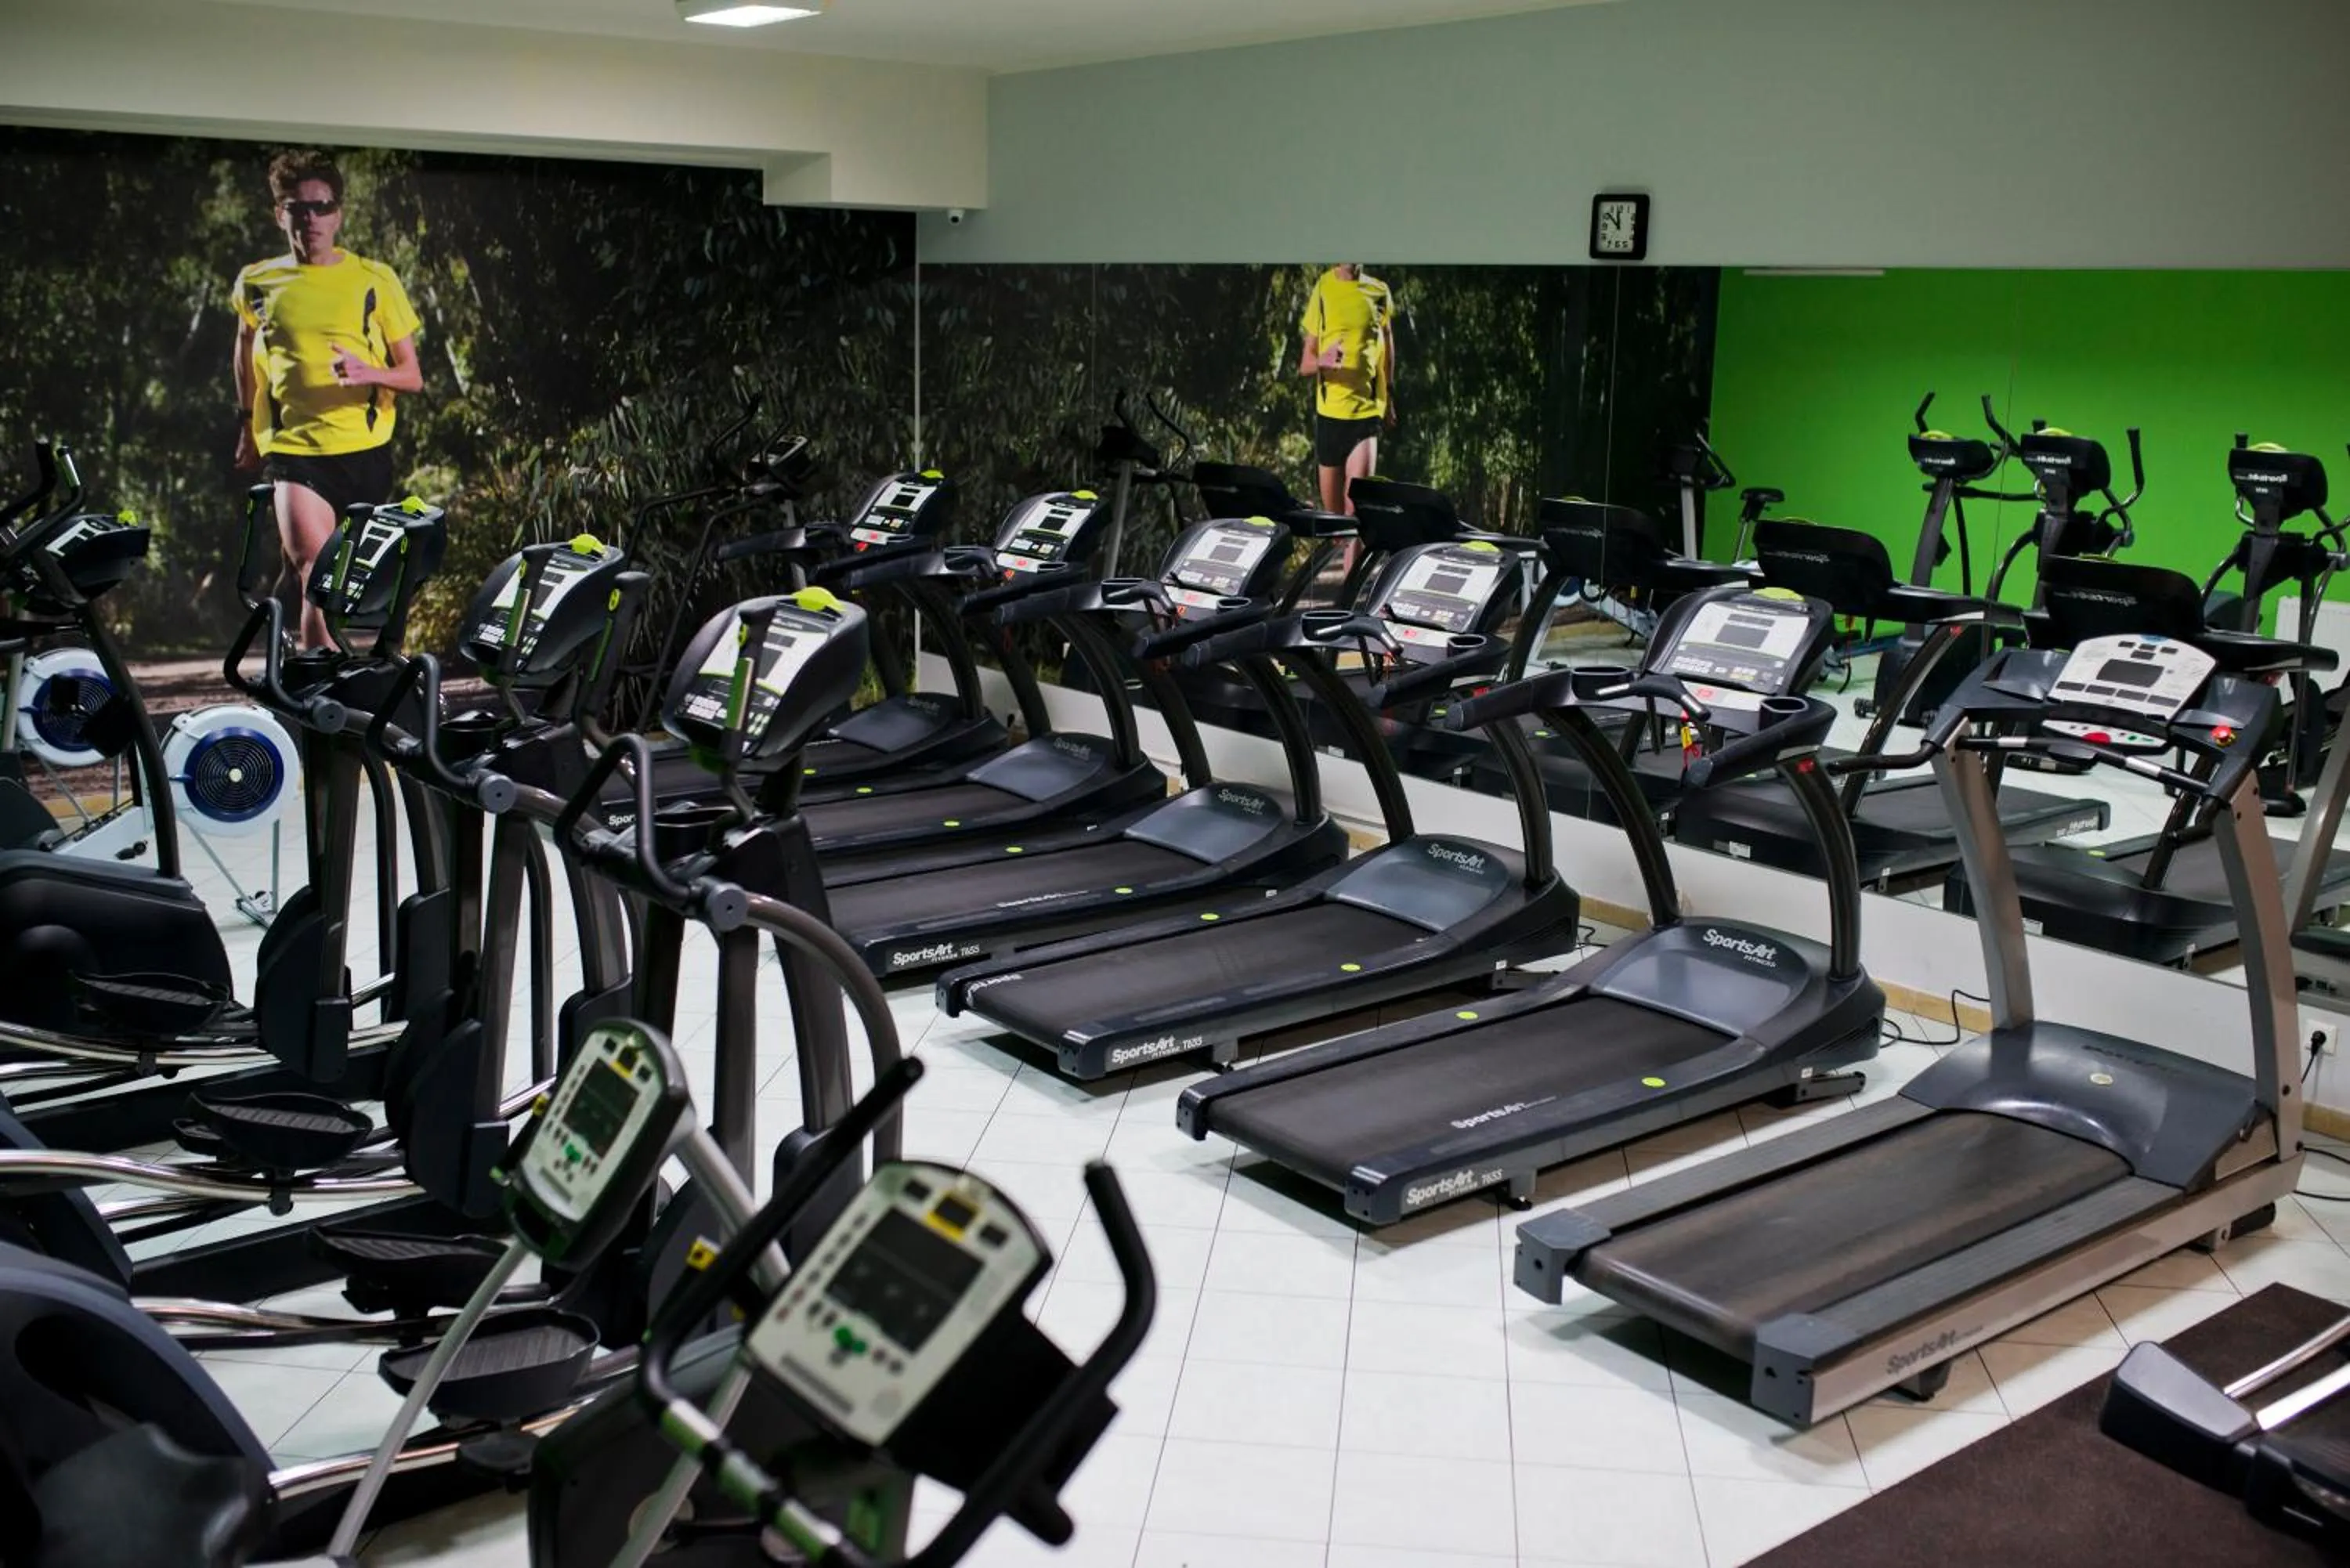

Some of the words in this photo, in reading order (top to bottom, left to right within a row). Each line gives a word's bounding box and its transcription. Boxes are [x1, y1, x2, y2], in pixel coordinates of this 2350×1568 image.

[1428, 844, 1484, 869] SportsArt
[893, 943, 953, 965] SportsArt
[1703, 929, 1777, 960] SportsArt
[1112, 1035, 1175, 1064] SportsArt
[1407, 1169, 1473, 1205] SportsArt
